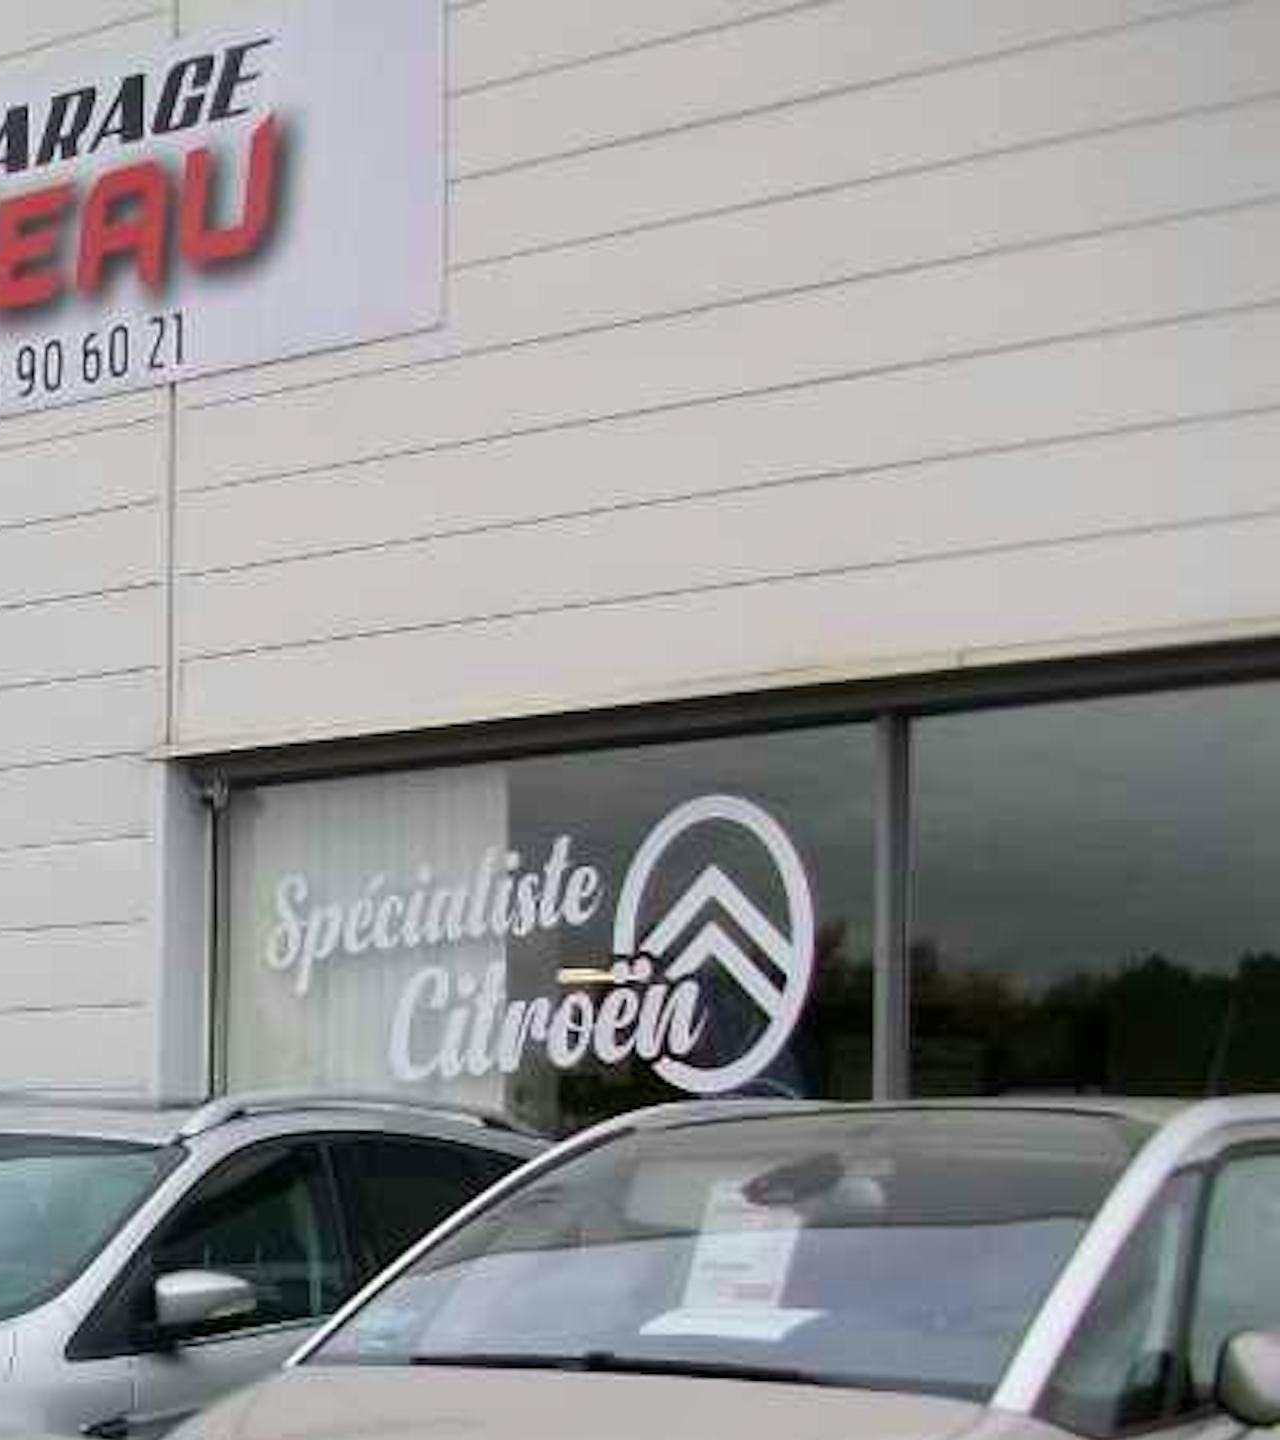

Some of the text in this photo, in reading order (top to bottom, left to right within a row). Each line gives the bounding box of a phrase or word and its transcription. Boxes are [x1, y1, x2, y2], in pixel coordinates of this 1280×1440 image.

[17, 339, 64, 397] 90
[82, 324, 129, 384] 60
[149, 313, 184, 370] 21
[266, 834, 601, 994] Spécialiste
[389, 958, 707, 1081] Citroën
